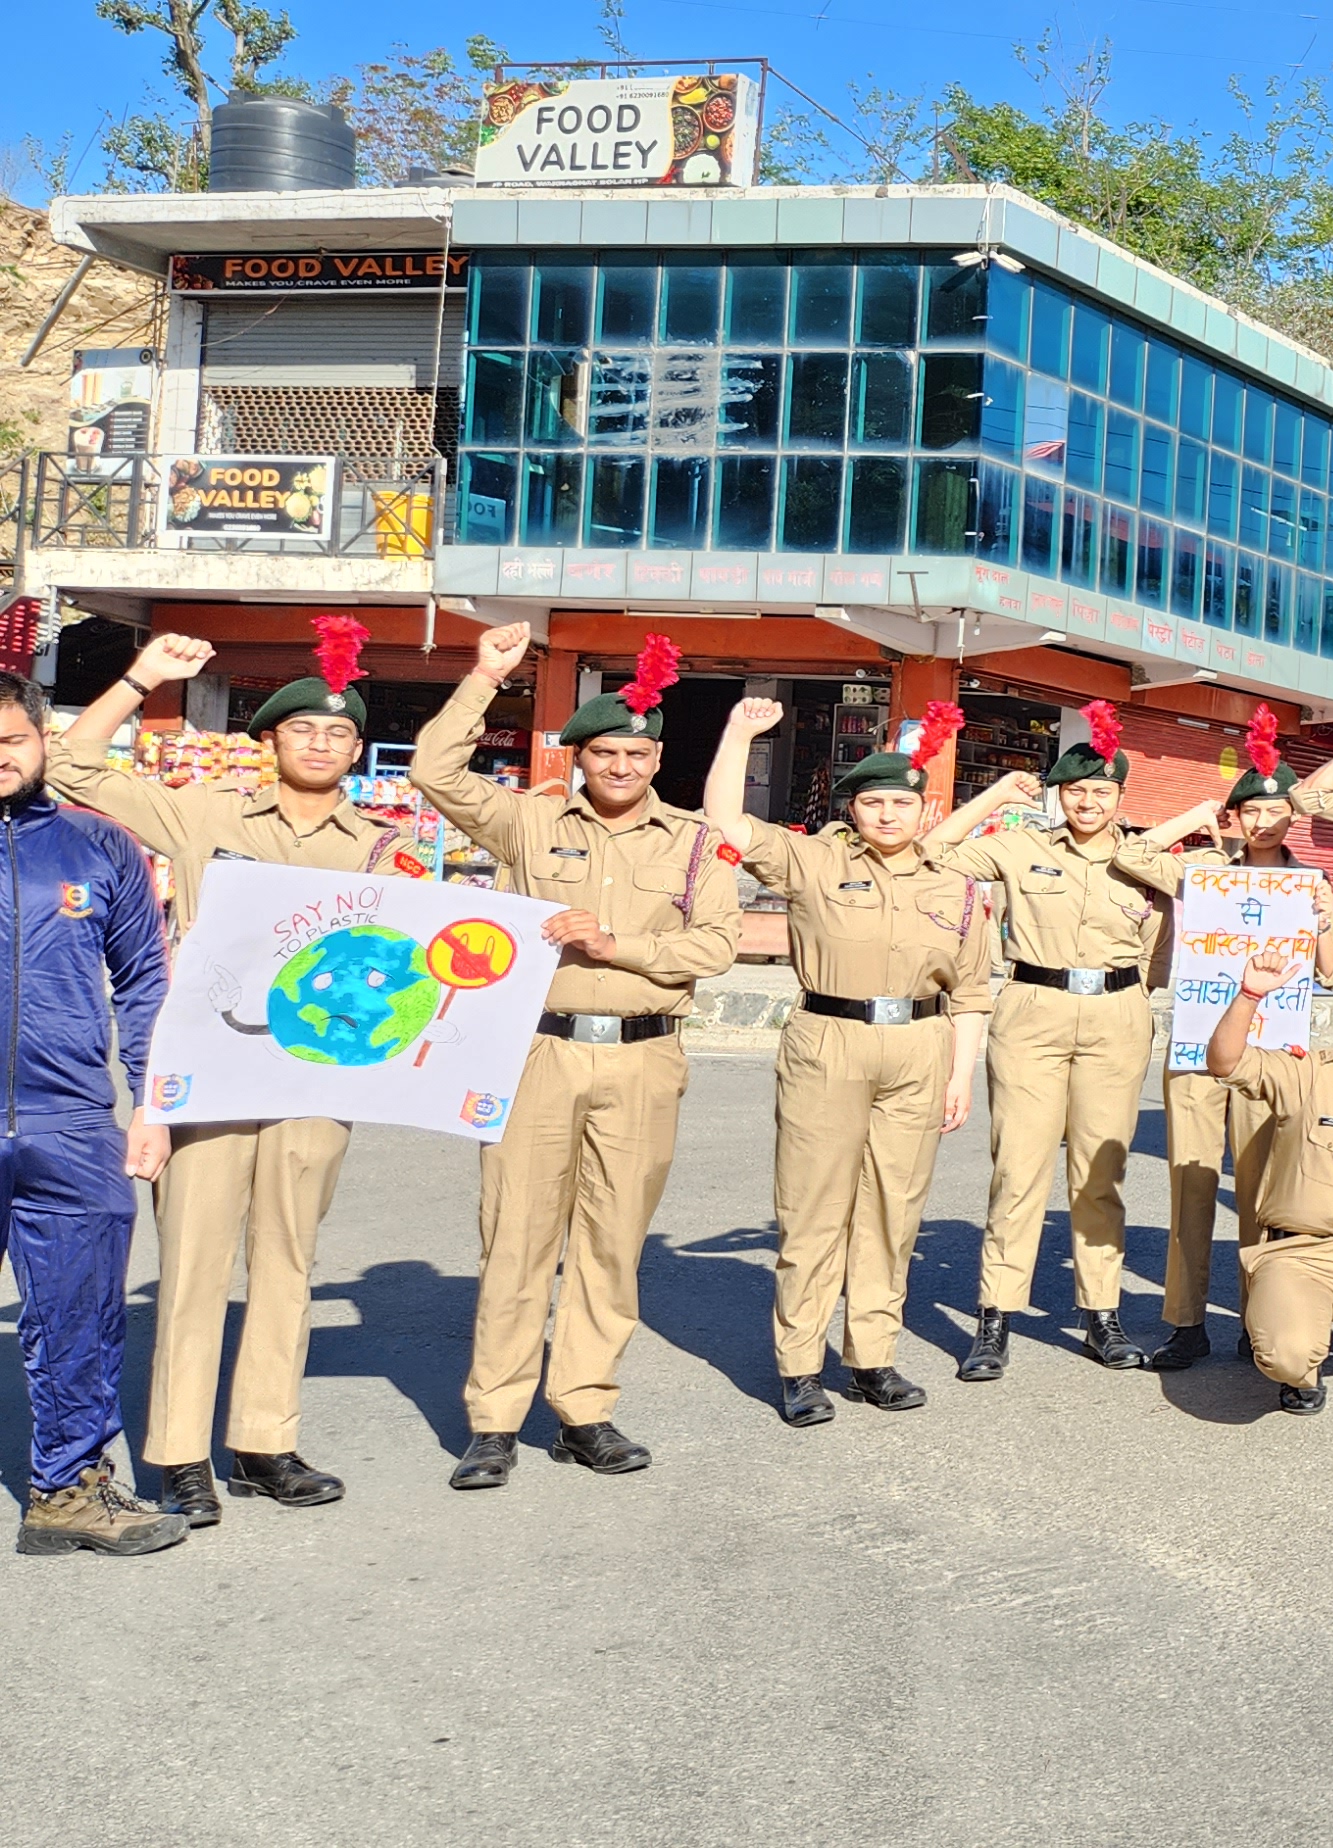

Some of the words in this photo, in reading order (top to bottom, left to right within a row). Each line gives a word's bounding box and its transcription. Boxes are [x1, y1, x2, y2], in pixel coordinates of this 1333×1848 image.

[536, 104, 641, 135] FOOD
[517, 139, 658, 172] VALLEY
[224, 258, 322, 278] FOOD
[334, 255, 469, 276] VALLEY
[209, 467, 280, 487] FOOD
[197, 489, 291, 509] VALLEY
[273, 901, 323, 943] SAY
[337, 886, 385, 914] NO!
[1235, 897, 1271, 926] से
[273, 938, 302, 960] TO
[306, 912, 379, 942] PLASTIC
